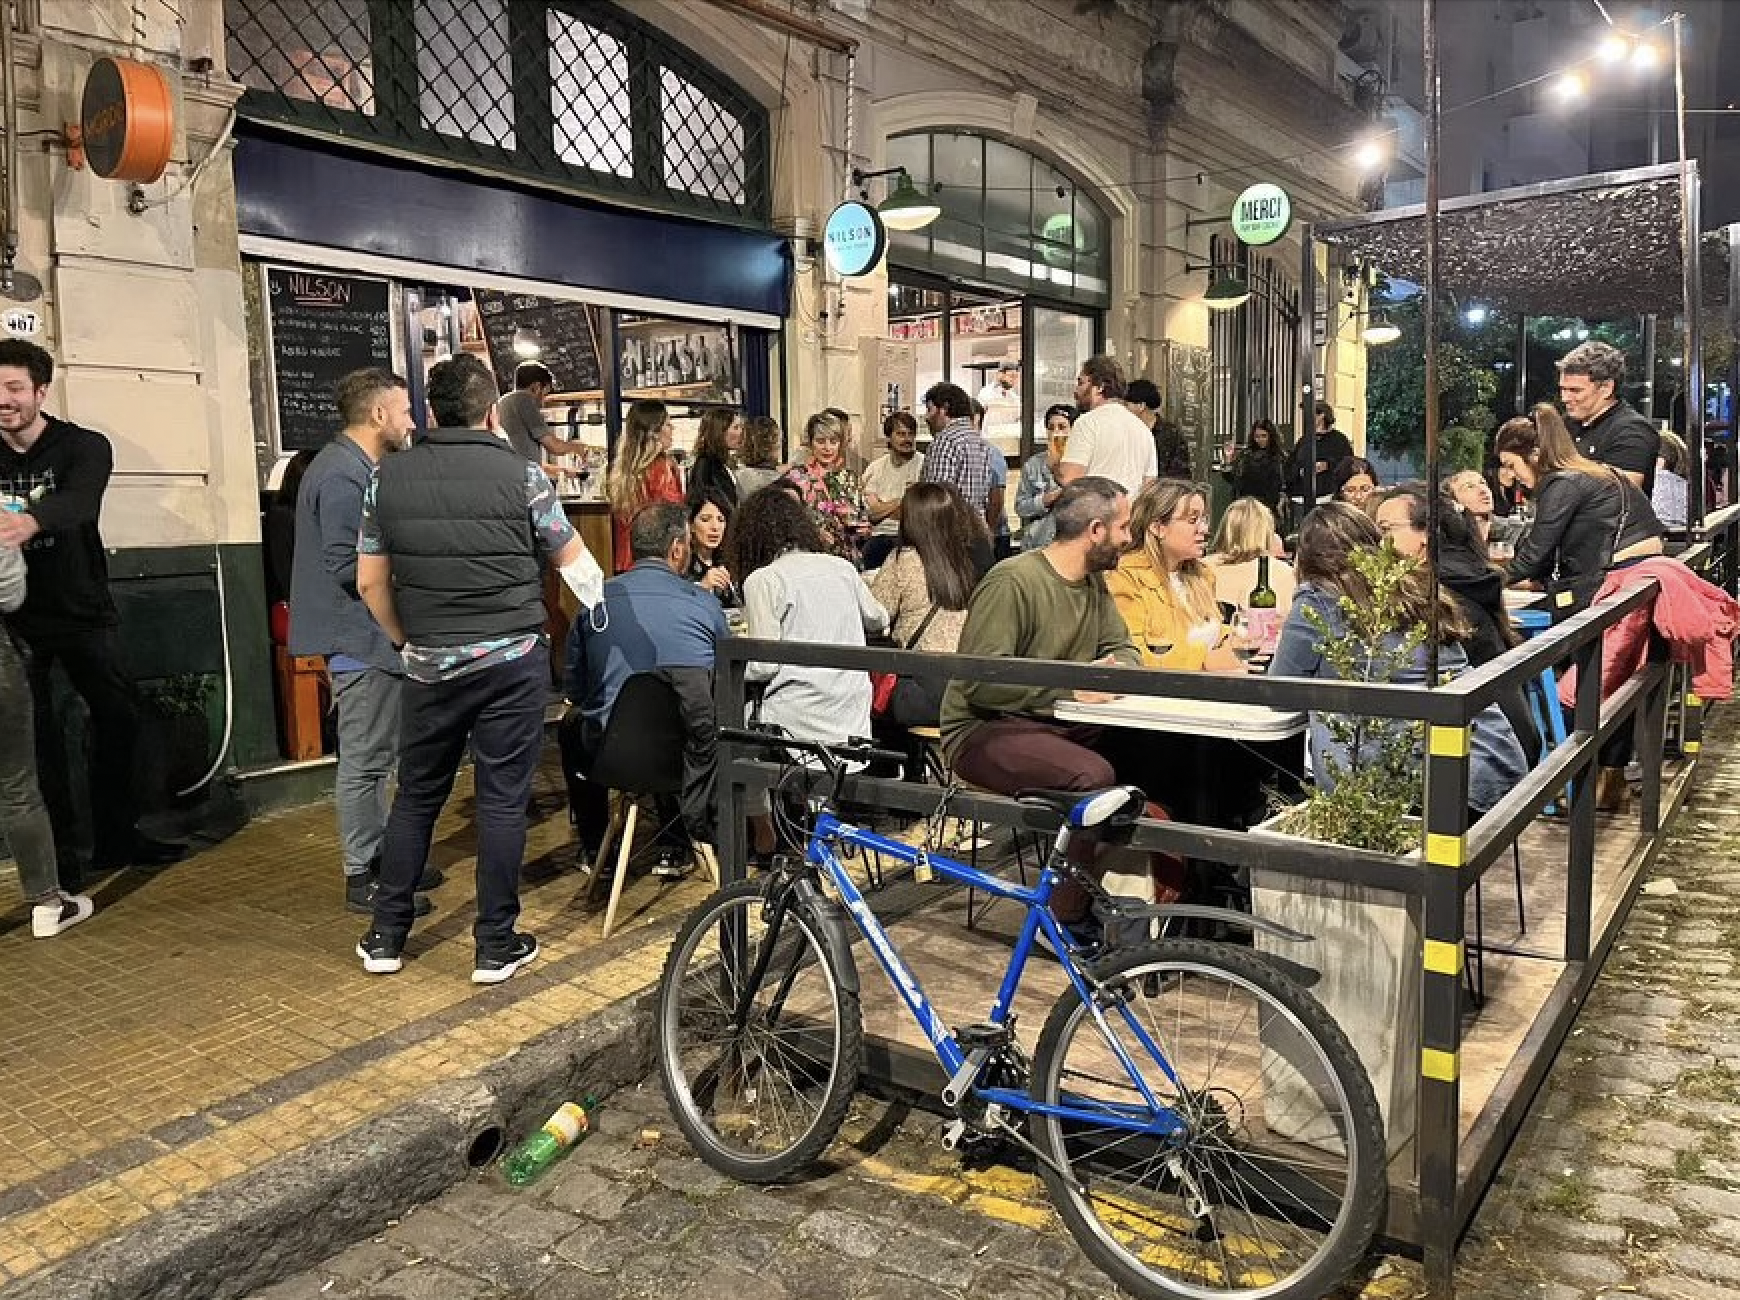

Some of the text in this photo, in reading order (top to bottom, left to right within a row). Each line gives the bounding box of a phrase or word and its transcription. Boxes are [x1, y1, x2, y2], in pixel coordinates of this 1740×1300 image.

[1241, 197, 1282, 222] MERCI
[828, 226, 872, 243] NILSON
[289, 274, 350, 302] NILSON
